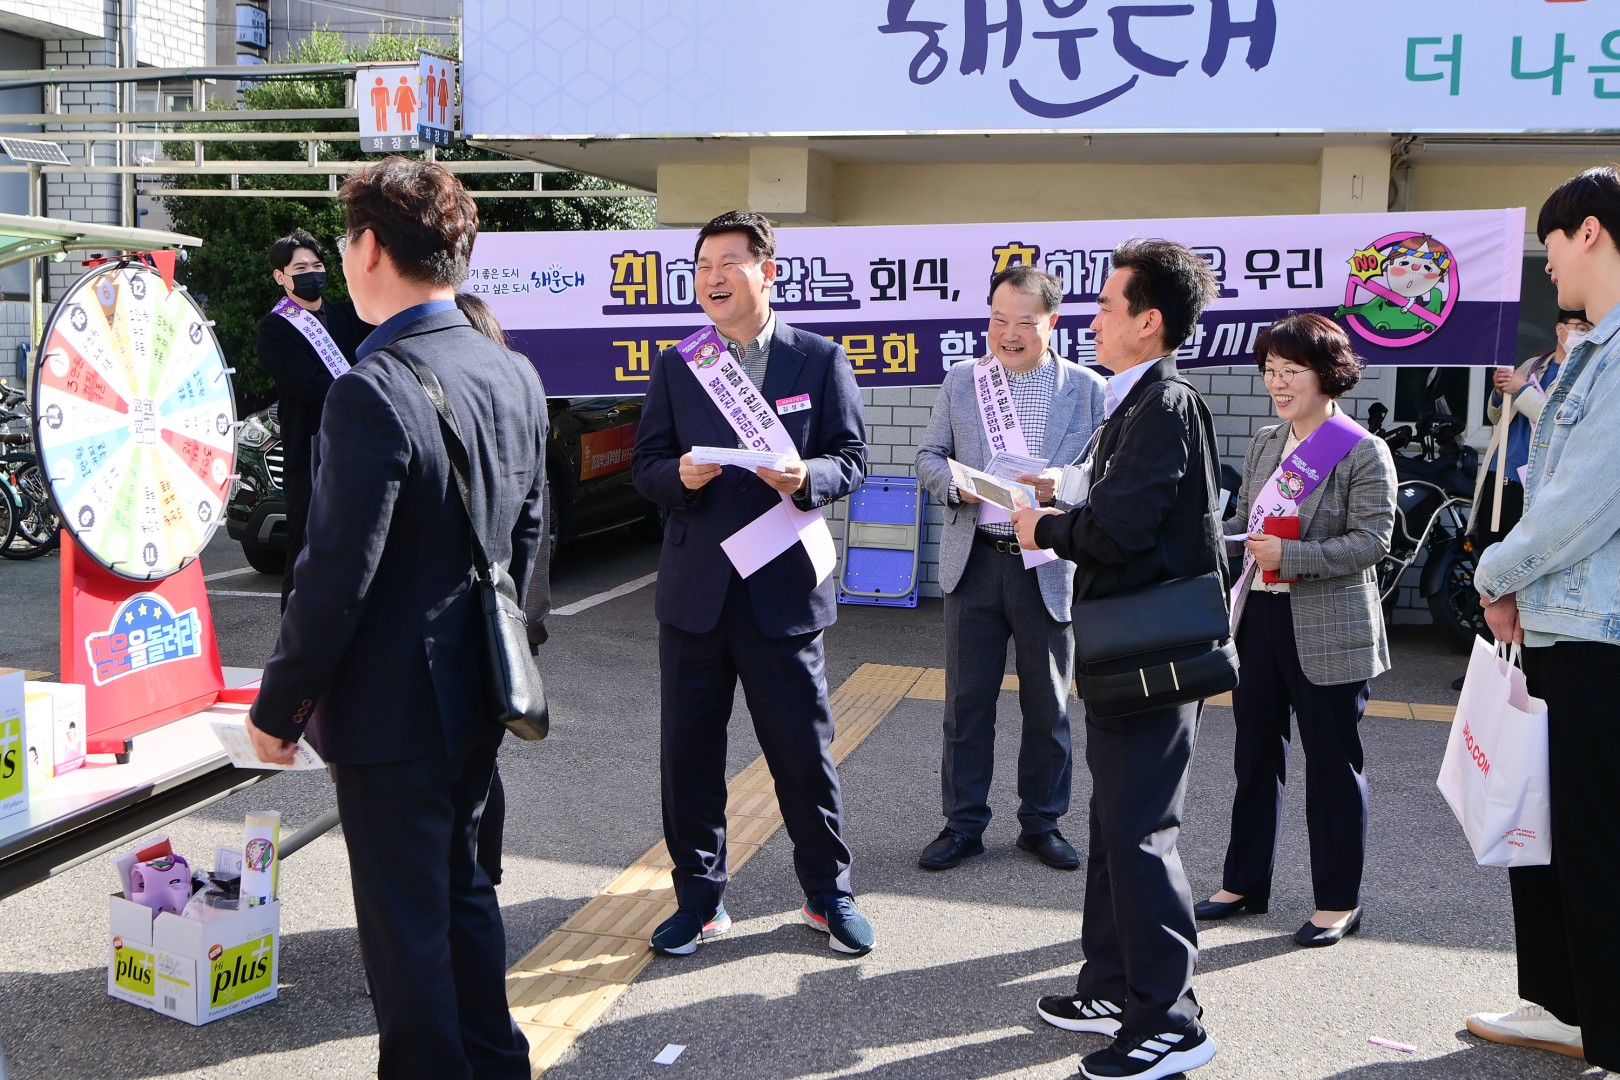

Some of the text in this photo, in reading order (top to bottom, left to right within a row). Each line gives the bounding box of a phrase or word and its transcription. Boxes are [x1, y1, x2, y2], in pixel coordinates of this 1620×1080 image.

[1405, 33, 1463, 97] 더
[372, 136, 420, 150] 화장실
[425, 128, 449, 145] 화장실
[1353, 254, 1379, 273] NO
[465, 268, 520, 280] 기 좋은 도시
[530, 268, 585, 294] 해운대
[869, 257, 961, 302] 회식,
[1243, 247, 1323, 290] 우리
[472, 283, 530, 295] 오고 싶은 도시
[738, 386, 751, 397] 수
[116, 956, 152, 984] plus
[214, 960, 224, 972] Hi
[212, 954, 268, 1004] plus
